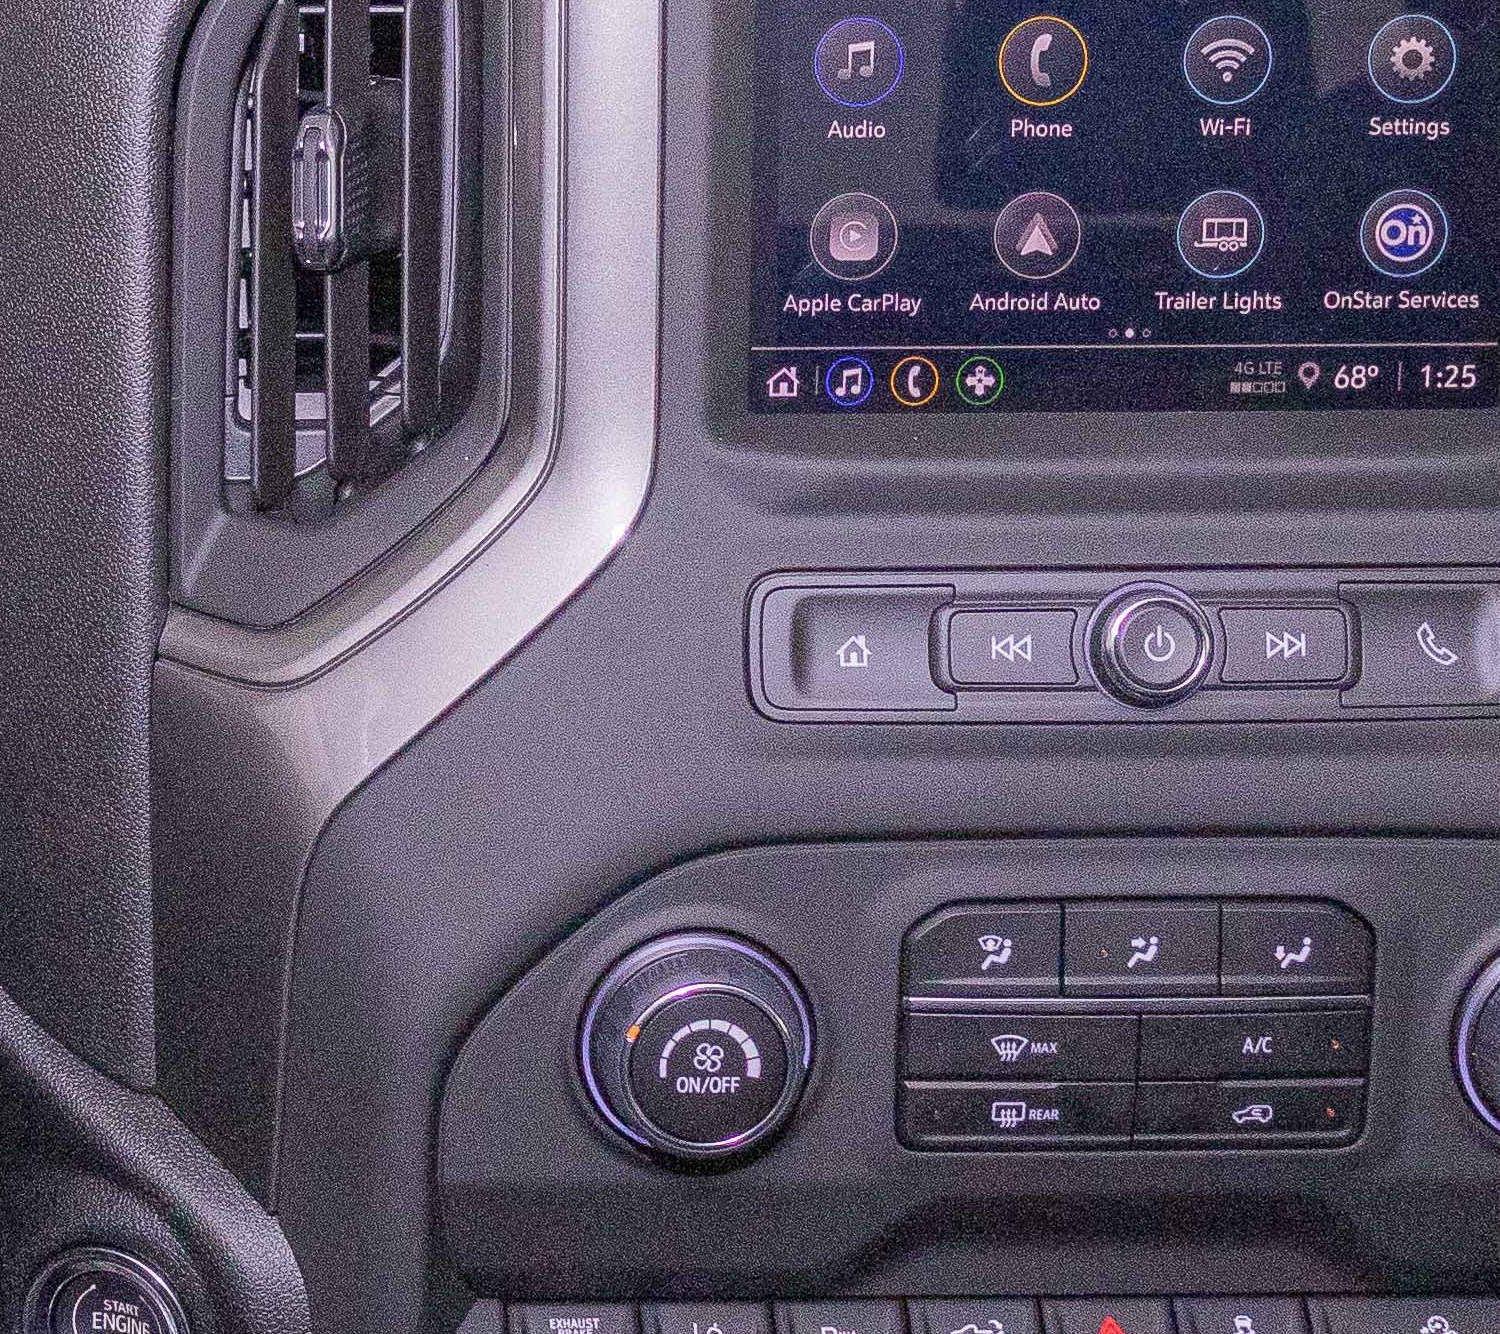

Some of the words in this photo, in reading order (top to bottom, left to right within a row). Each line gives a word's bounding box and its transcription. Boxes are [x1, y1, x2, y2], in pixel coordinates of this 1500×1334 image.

[827, 119, 886, 139] Audio
[1010, 118, 1073, 138] Phone
[1199, 117, 1251, 136] Wi-Fi
[1369, 117, 1450, 140] Settings
[783, 293, 842, 317] Apple
[848, 292, 922, 317] CarPlay
[969, 291, 1049, 311] Android
[1053, 292, 1101, 311] Auto
[1154, 290, 1217, 310] Trailer
[1222, 290, 1283, 315] Lights
[1323, 289, 1394, 310] OnStar
[1399, 289, 1480, 310] Services
[1234, 361, 1255, 376] 4G
[1258, 361, 1282, 376] LTE
[1420, 364, 1477, 389] 1:25
[1030, 1042, 1058, 1054] MAX
[1242, 1036, 1272, 1055] A/C
[676, 1076, 741, 1094] ON/OFF
[1028, 1108, 1060, 1121] REAR
[103, 1298, 139, 1319] START
[549, 1317, 600, 1331] EXHAUST
